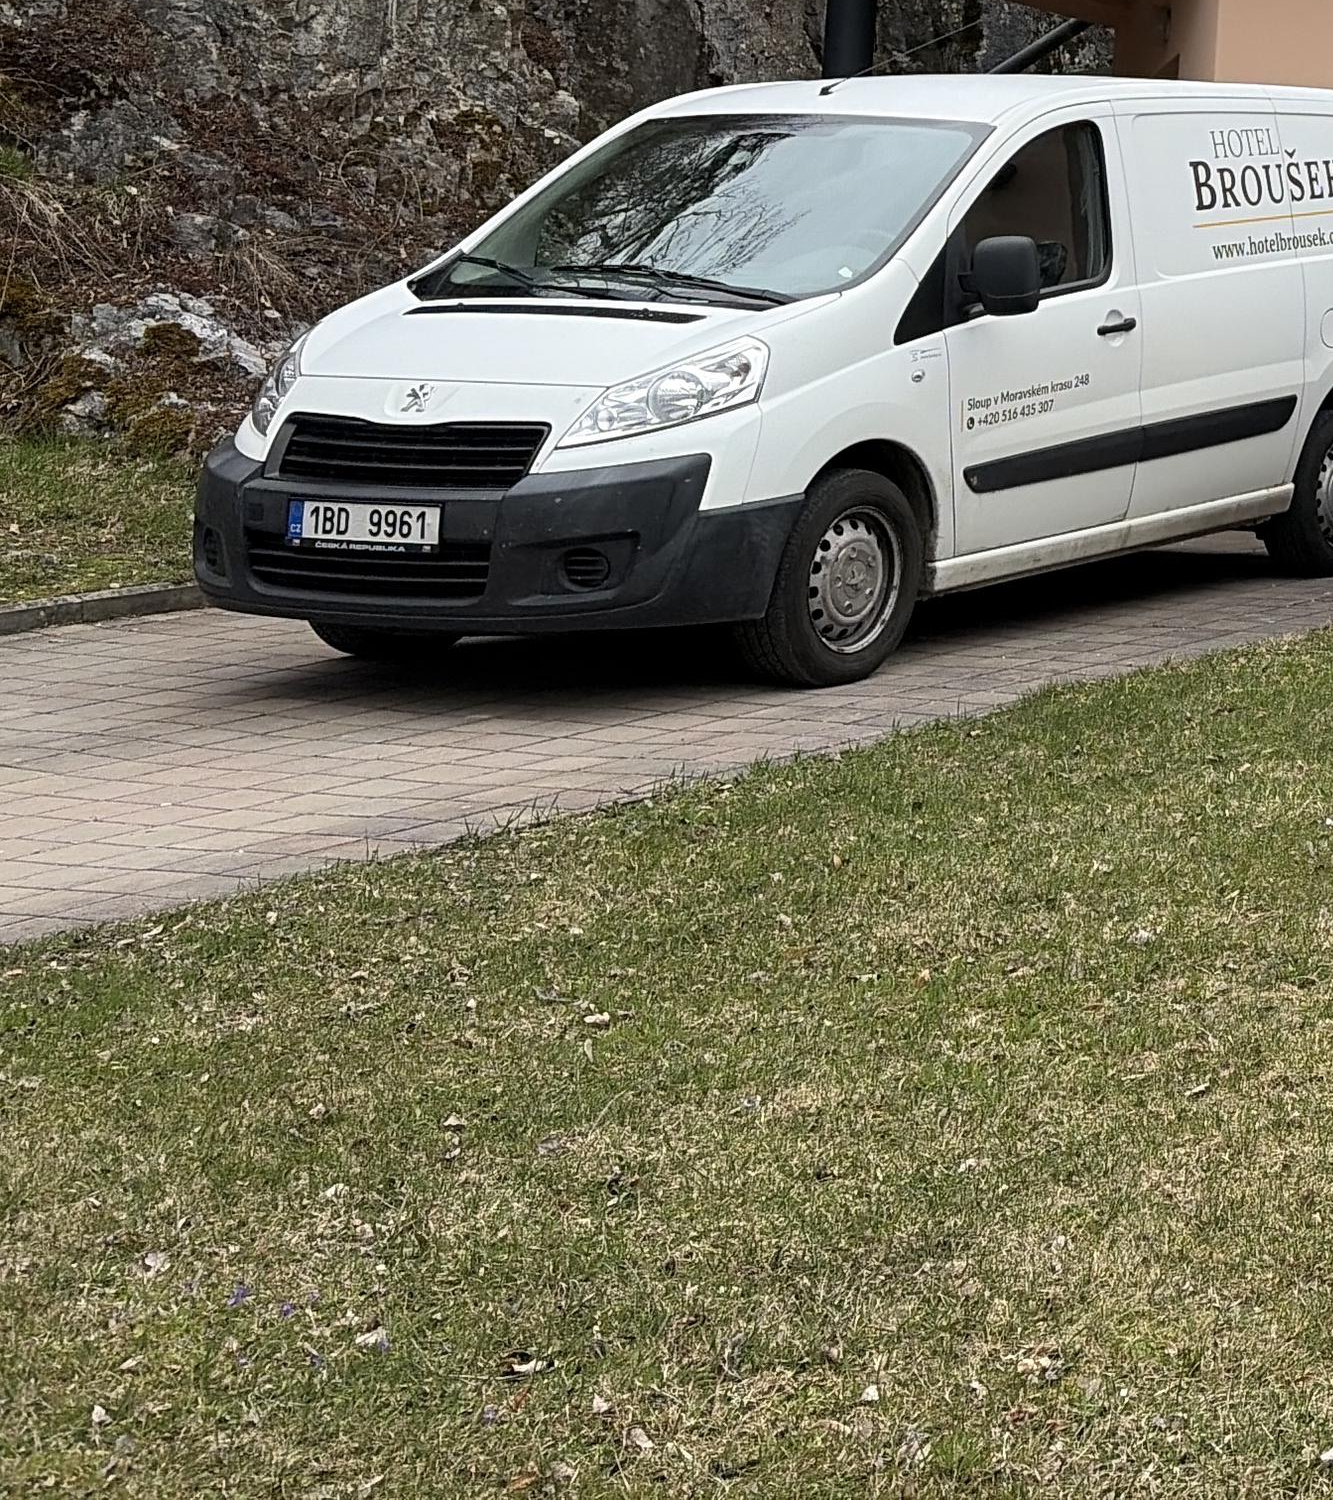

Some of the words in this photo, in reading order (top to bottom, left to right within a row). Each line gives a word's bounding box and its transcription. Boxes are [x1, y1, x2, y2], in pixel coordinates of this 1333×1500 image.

[1209, 128, 1280, 159] HOTEL
[967, 398, 992, 411] Sloup
[994, 396, 999, 405] v
[1001, 384, 1049, 404] Moravském
[1051, 381, 1073, 393] krasu
[1074, 373, 1090, 388] 248
[977, 411, 1000, 426] +420
[1002, 407, 1018, 422] 516
[1020, 403, 1036, 417] 435
[1038, 399, 1054, 414] 307
[290, 523, 301, 532] CZ
[310, 506, 350, 536] 1BD
[368, 509, 427, 540] 9961
[315, 541, 348, 550] ČESKÁ
[349, 543, 405, 552] REPUBLIKA
